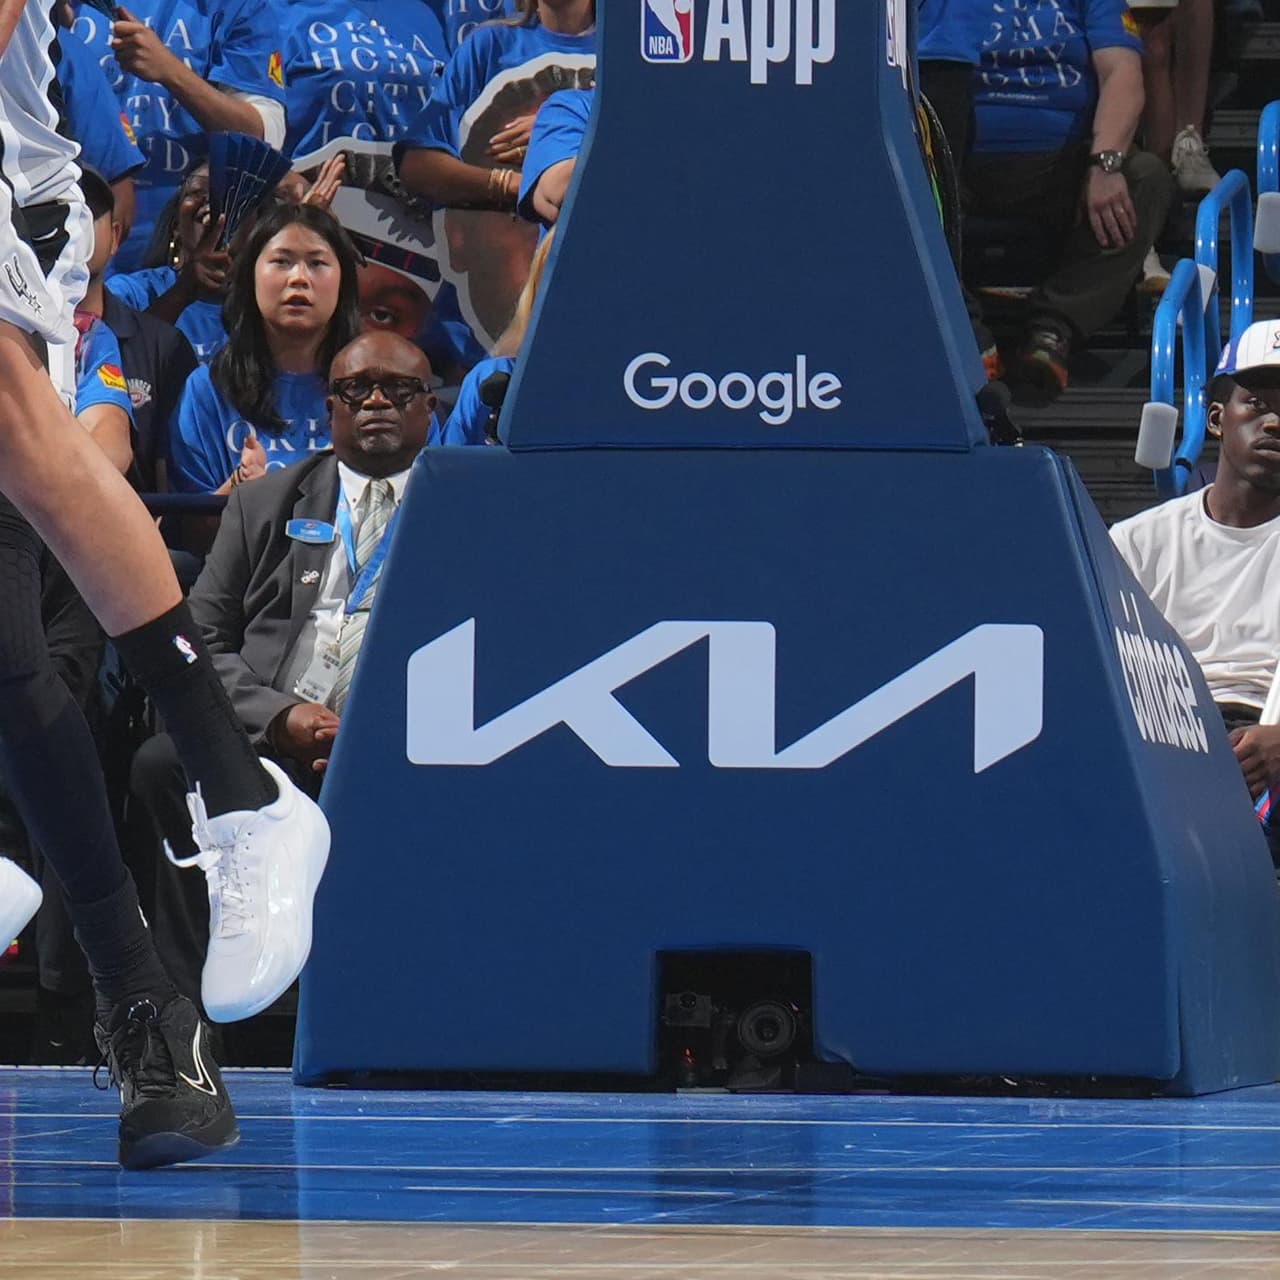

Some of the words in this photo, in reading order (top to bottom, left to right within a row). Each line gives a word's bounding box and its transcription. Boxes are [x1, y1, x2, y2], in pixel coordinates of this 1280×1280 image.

[309, 21, 437, 60] OKLA
[649, 35, 673, 55] NBA
[330, 81, 437, 115] CITY
[624, 352, 843, 426] Google
[227, 421, 331, 451] OKL
[1115, 590, 1209, 754] coinbase
